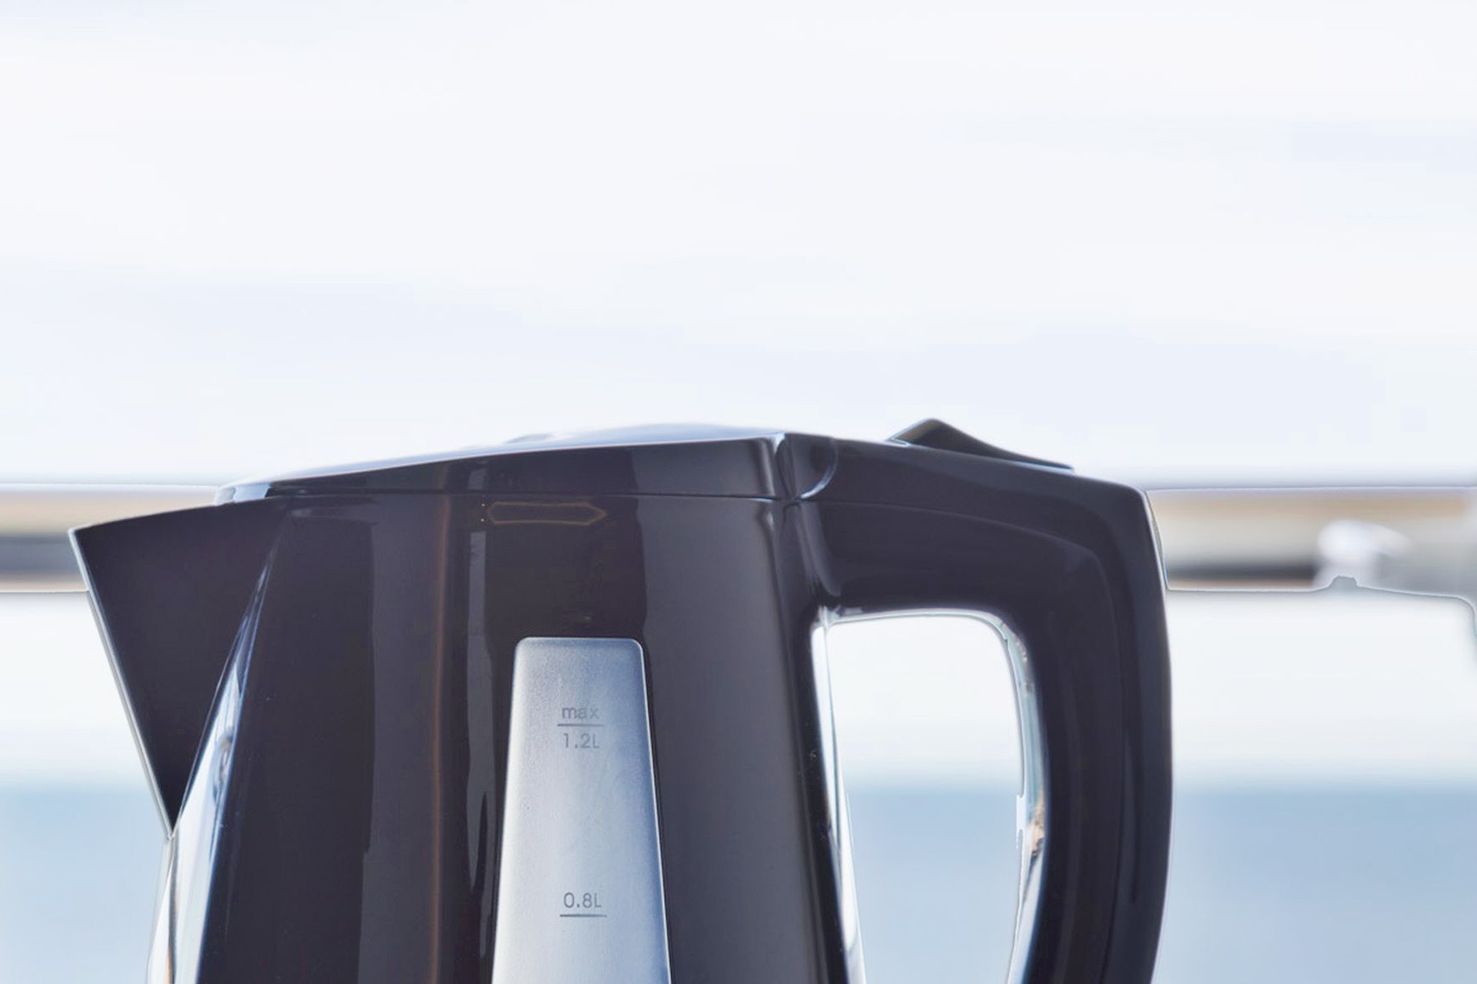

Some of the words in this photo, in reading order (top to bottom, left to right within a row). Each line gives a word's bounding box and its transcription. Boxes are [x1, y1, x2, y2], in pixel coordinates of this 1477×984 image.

[562, 707, 600, 720] max
[563, 732, 600, 749] 1.2L
[563, 892, 602, 909] 0.8L
